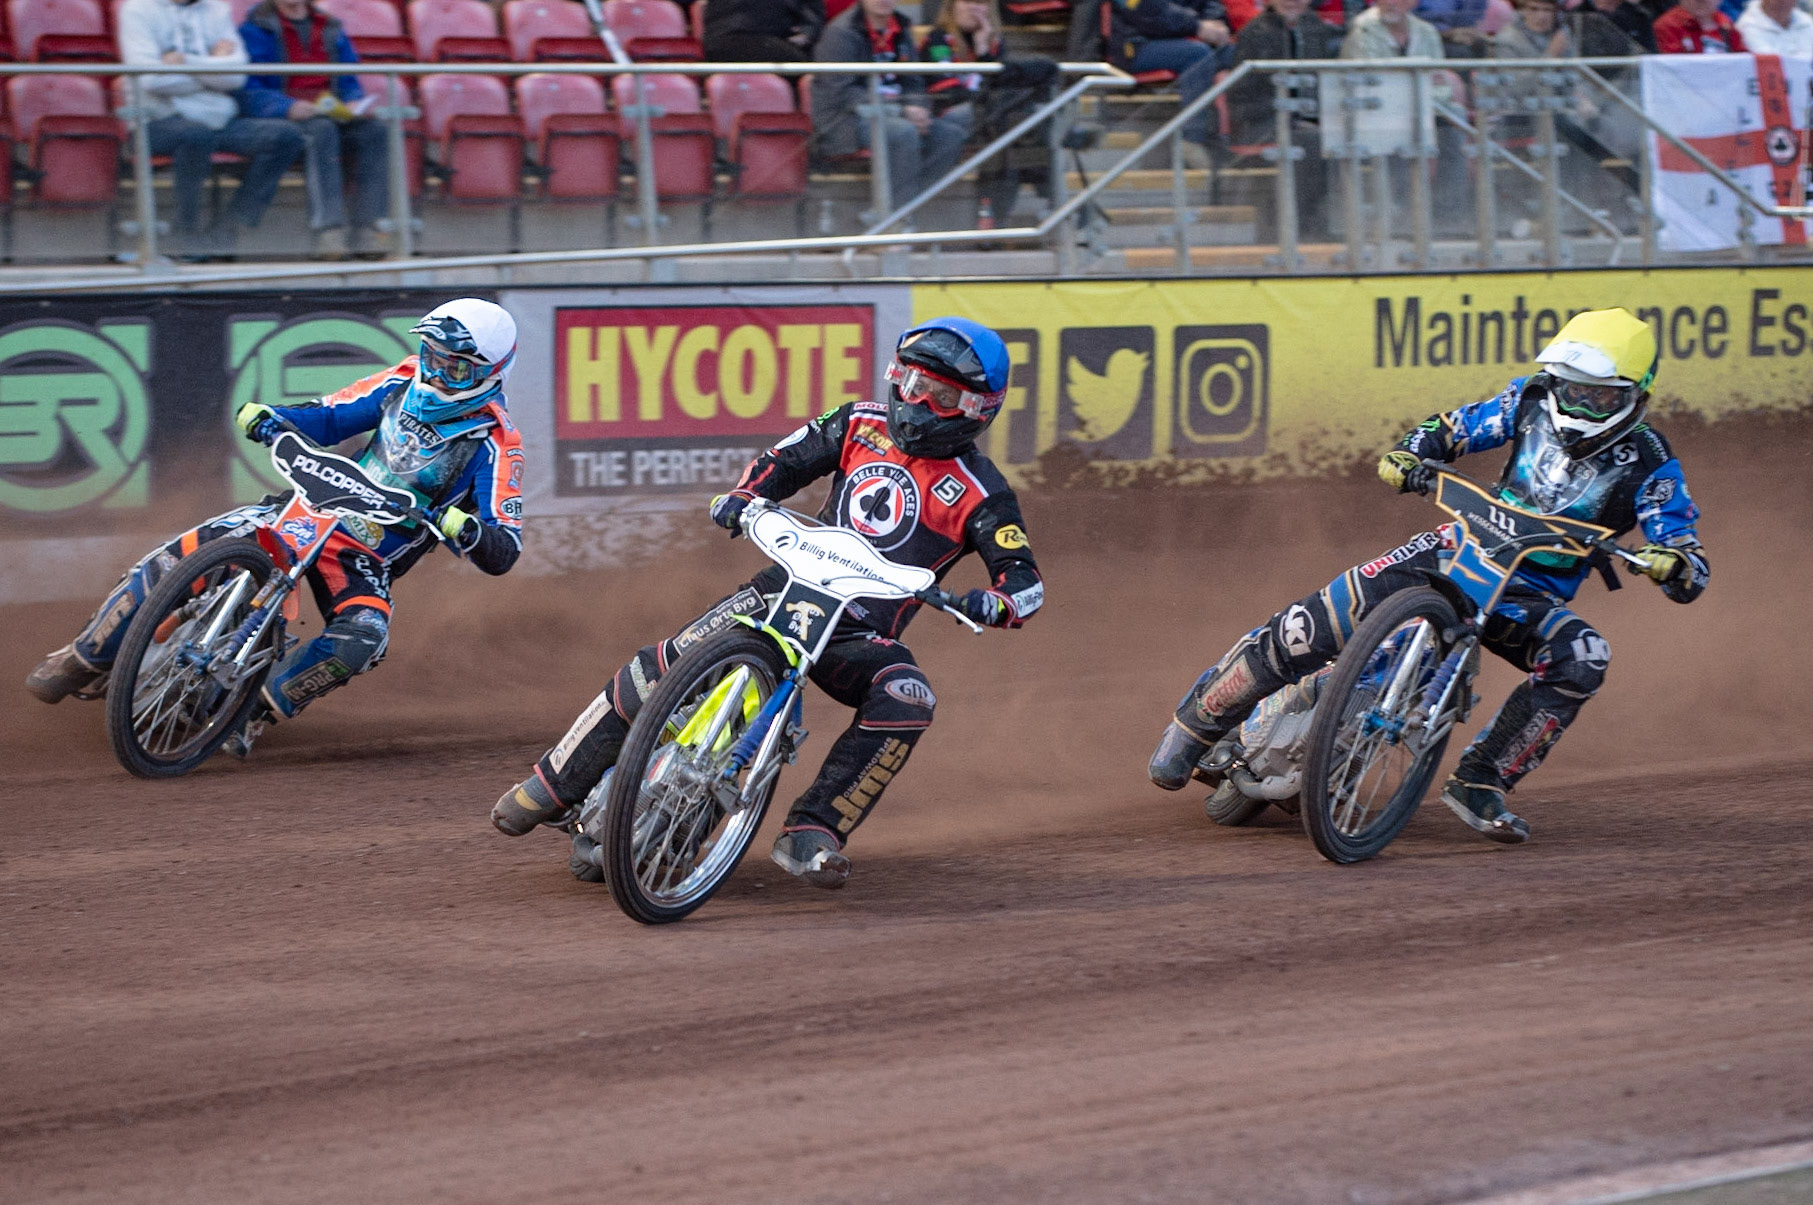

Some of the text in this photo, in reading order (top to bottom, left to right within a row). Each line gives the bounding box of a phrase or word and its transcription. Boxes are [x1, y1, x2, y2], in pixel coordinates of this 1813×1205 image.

[1373, 288, 1813, 368] Maintence Es
[566, 323, 864, 422] HYCOTE
[400, 414, 440, 445] PIRATES
[291, 454, 387, 510] POLCOPPER
[568, 451, 630, 488] THE
[851, 466, 915, 518] BELLE VUE ACES
[937, 481, 962, 501] 5
[799, 541, 826, 560] Billig
[1361, 532, 1440, 578] UNIFILTER
[678, 624, 710, 648] Claus
[733, 595, 757, 613] Byg
